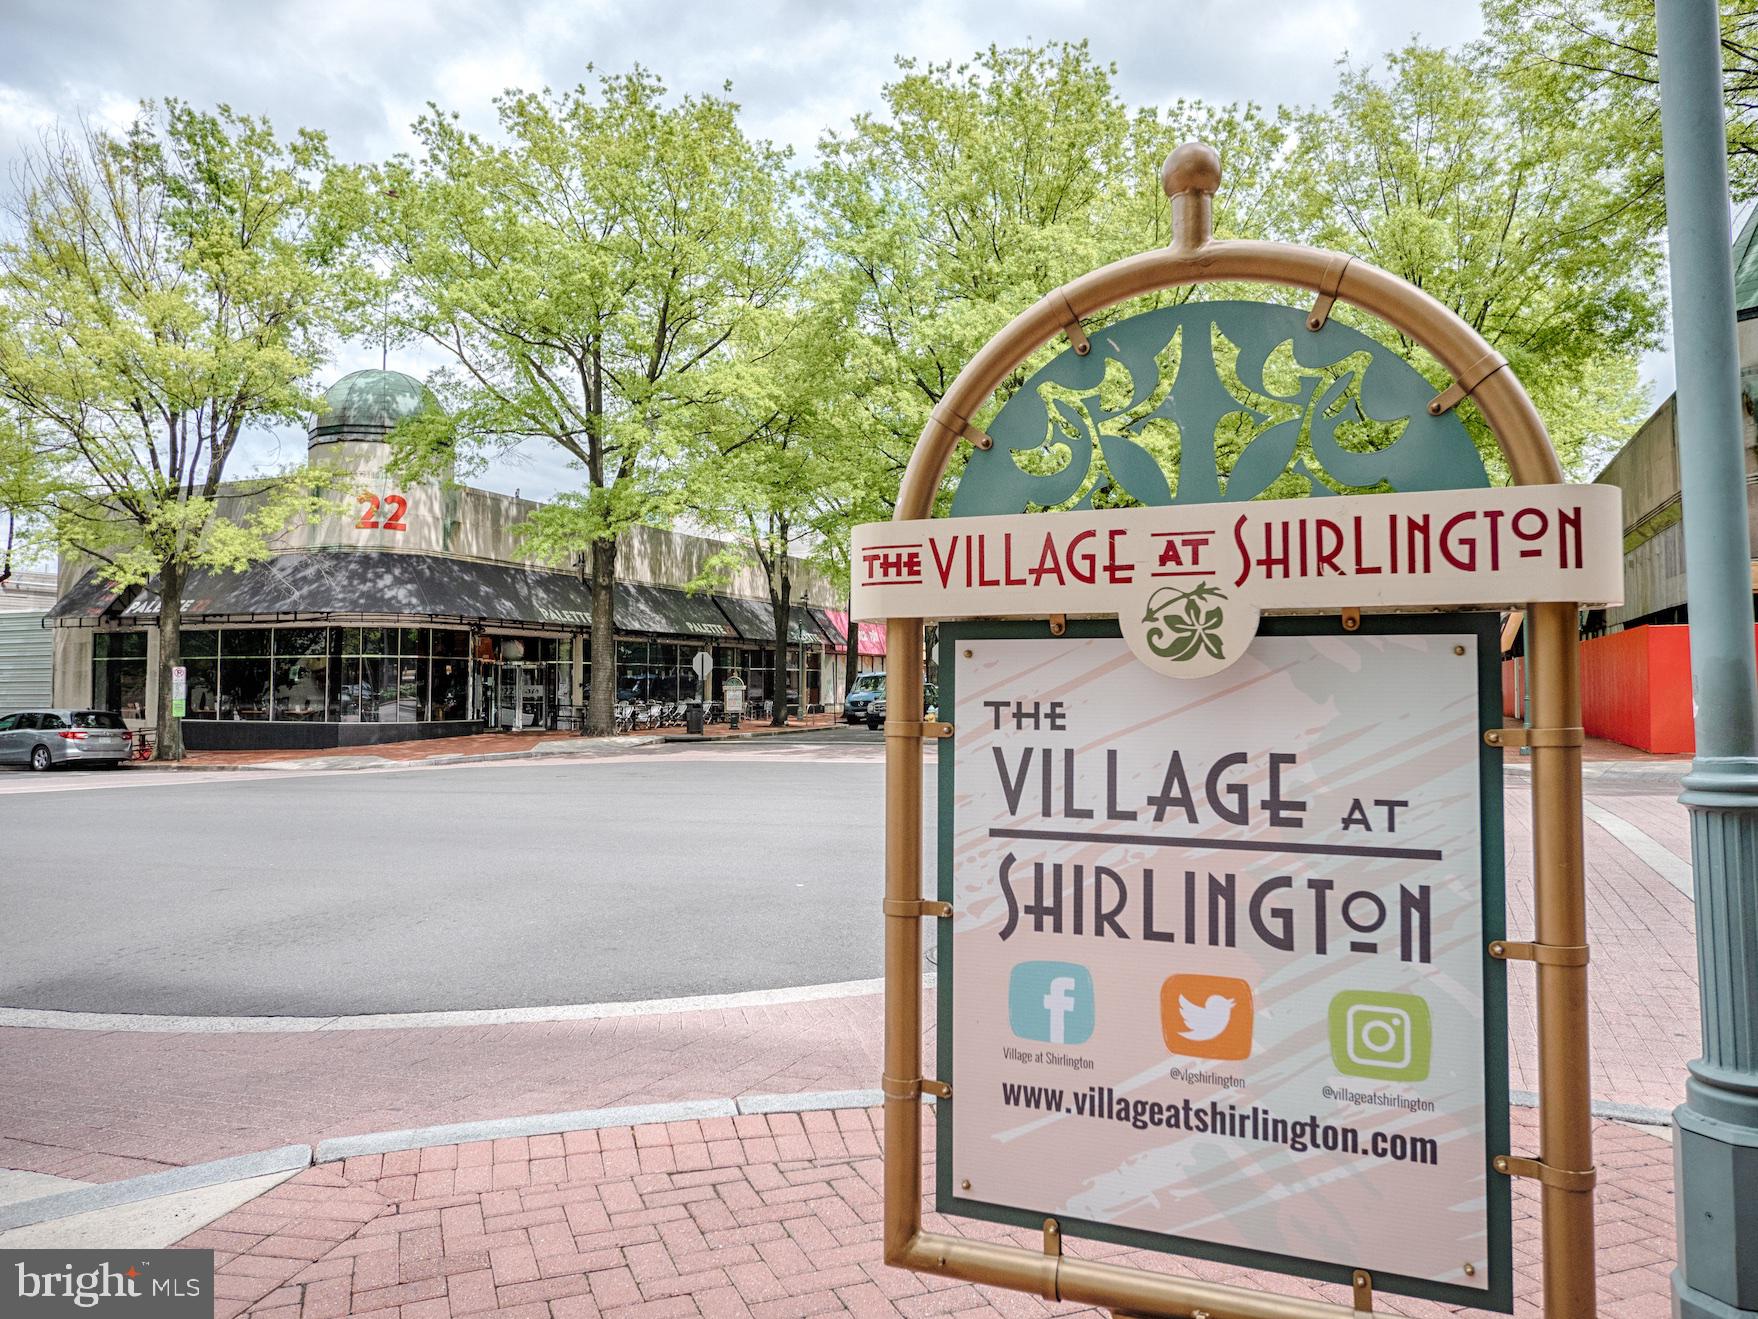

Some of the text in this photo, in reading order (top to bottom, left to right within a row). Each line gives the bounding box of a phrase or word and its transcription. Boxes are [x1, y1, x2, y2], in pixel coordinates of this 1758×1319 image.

[355, 493, 407, 532] 22
[863, 507, 1583, 589] THE VILLAGE AT SHIRLINGTON
[125, 600, 195, 614] PALEE
[538, 608, 592, 623] PALETTE
[984, 701, 1067, 731] THE
[992, 746, 1409, 833] VILLAGE AT
[998, 851, 1431, 964] SHIRLINGTON
[1003, 1047, 1094, 1071] Village at Shirlington
[1170, 1067, 1246, 1089] @vlgshirlington
[1322, 1085, 1435, 1113] @villageatshirlington
[1002, 1082, 1438, 1166] www.villageatshirlington.com
